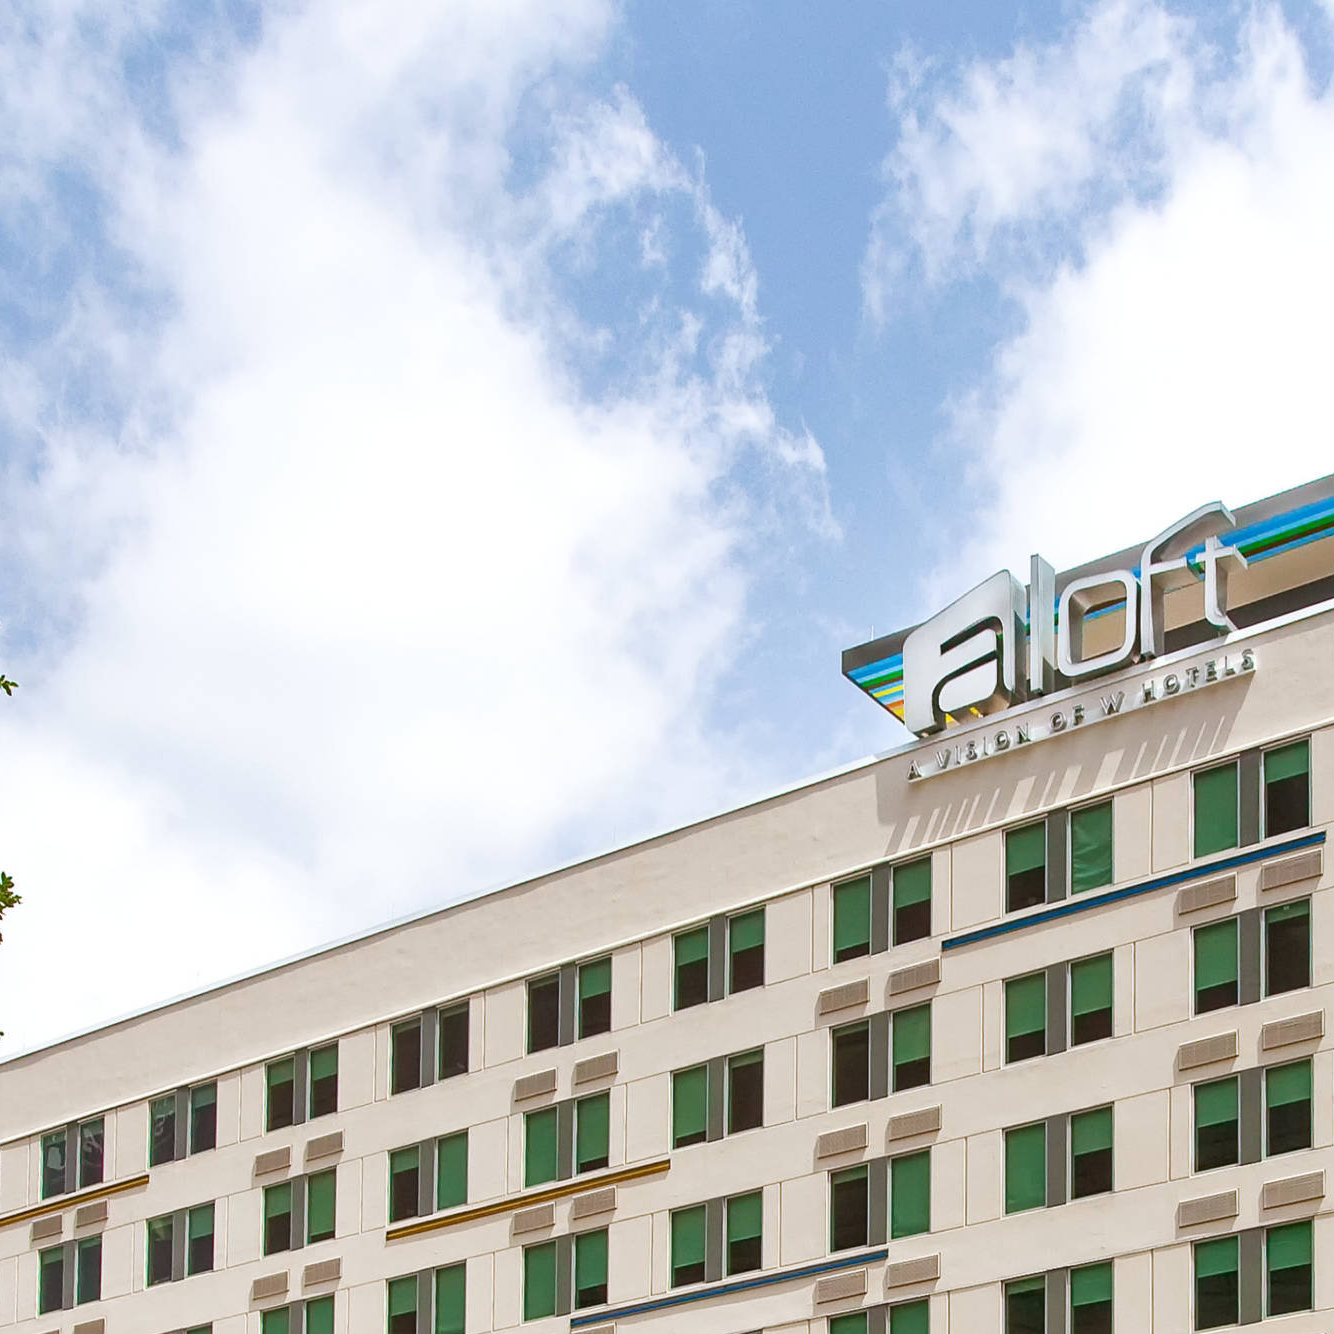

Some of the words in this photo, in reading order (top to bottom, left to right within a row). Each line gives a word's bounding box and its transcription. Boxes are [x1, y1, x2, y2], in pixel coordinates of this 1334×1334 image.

[903, 501, 1248, 734] aloft
[907, 759, 922, 780] A
[937, 721, 1031, 769] VISION
[1050, 704, 1084, 731] OF
[1099, 690, 1125, 715] W
[1142, 649, 1254, 703] HOTELS
